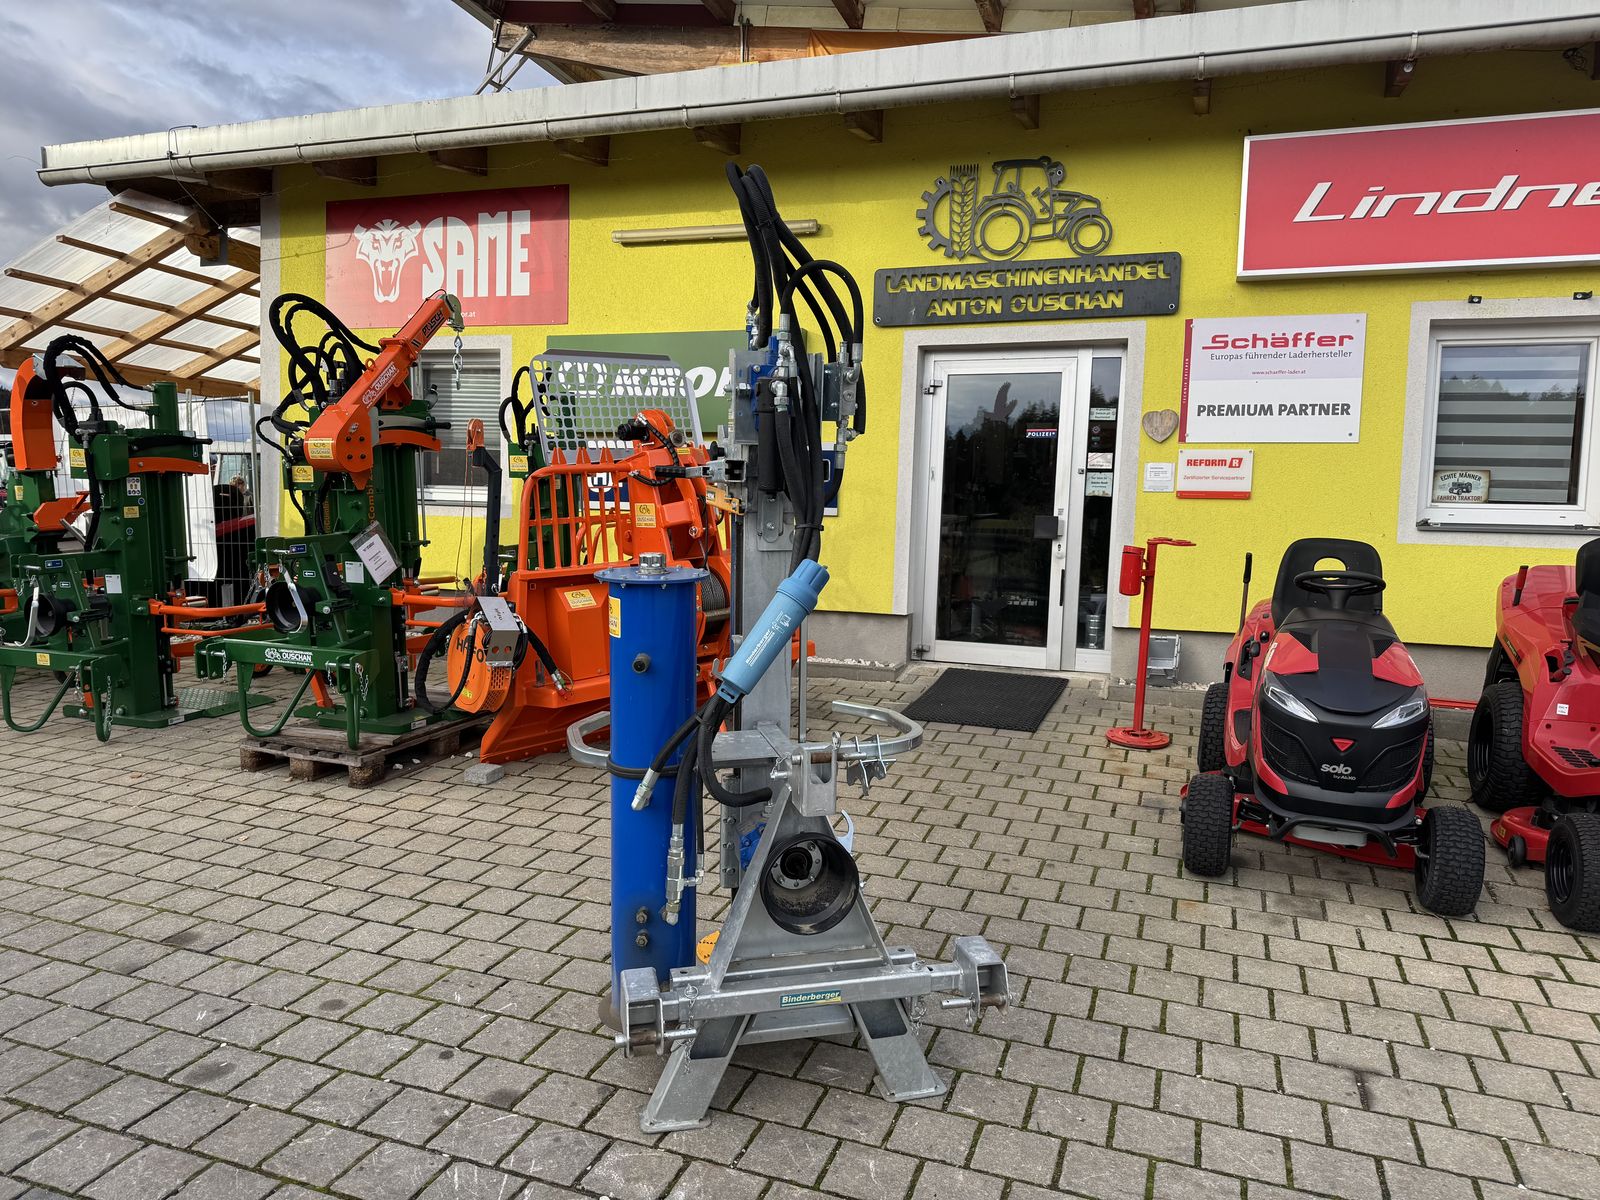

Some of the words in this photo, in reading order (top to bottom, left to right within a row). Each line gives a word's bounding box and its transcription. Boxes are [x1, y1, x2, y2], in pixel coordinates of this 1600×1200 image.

[421, 210, 531, 300] SAME
[885, 260, 1170, 293] LANDMASCHINENHANDEL
[925, 294, 1002, 317] ANTON
[1010, 290, 1123, 313] OUSCHAN
[1202, 332, 1354, 350] Schäffer
[1211, 353, 1243, 361] Europas
[1245, 351, 1287, 360] führender
[1289, 350, 1352, 359] Laderhersteller
[1197, 404, 1274, 417] PREMIUM
[1278, 403, 1351, 416] PARTNER
[1186, 458, 1227, 467] REFORM
[1440, 473, 1457, 481] ECHTE
[1459, 471, 1482, 481] MÄNNER
[282, 652, 312, 662] OUSCHAN
[1320, 763, 1352, 774] solo
[781, 991, 840, 1004] Binderberger
